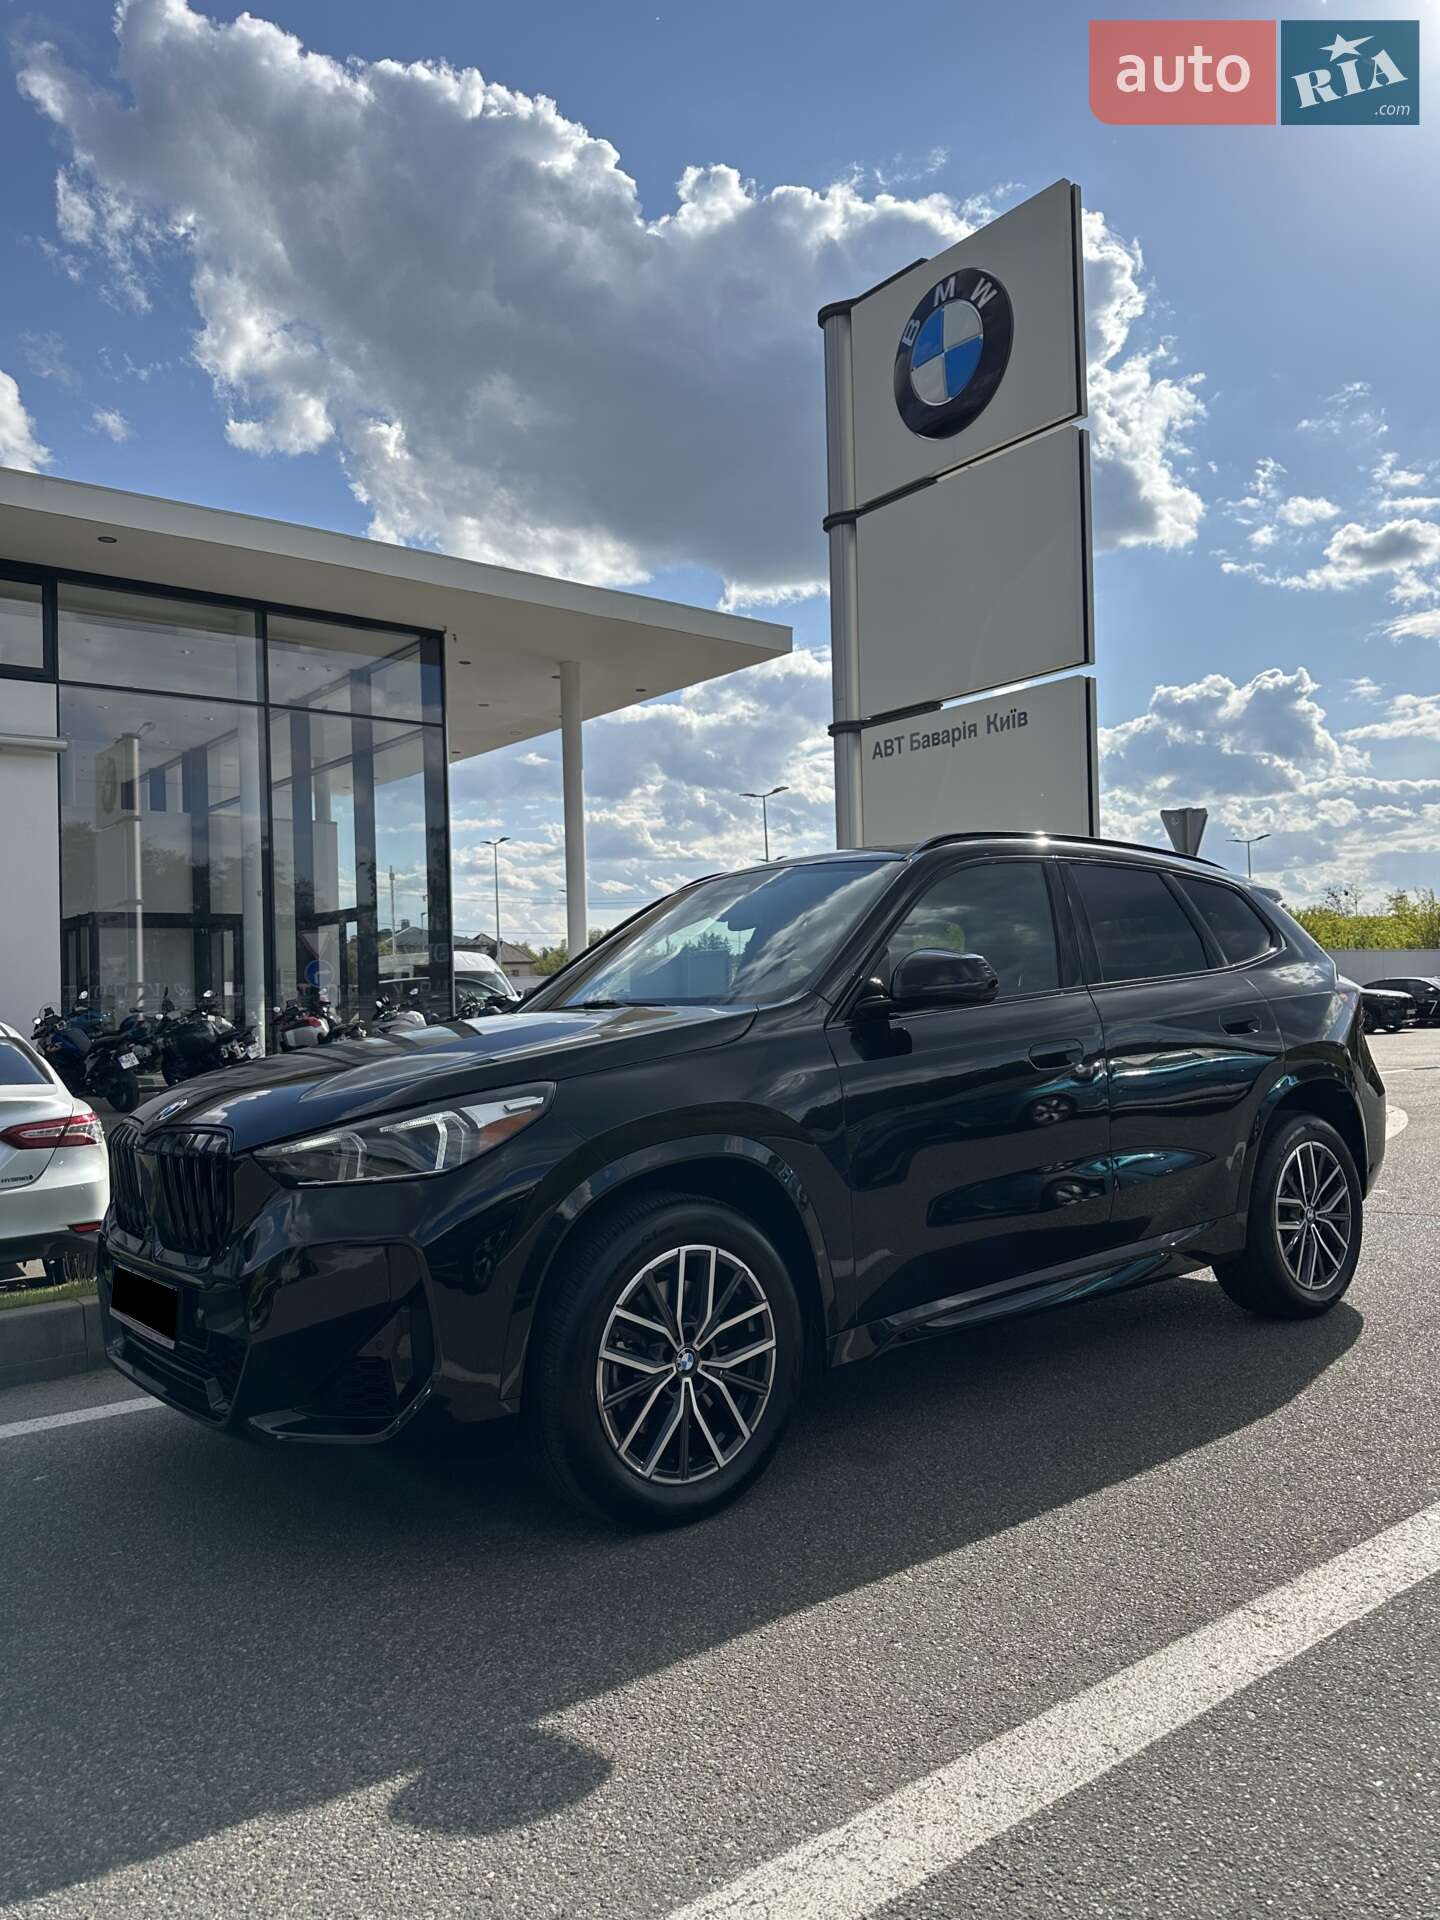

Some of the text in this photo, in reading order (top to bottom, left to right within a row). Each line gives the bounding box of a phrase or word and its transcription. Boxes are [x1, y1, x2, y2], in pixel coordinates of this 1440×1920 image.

[902, 276, 998, 347] BMW
[872, 709, 1029, 760] АВТ Баварія Київ
